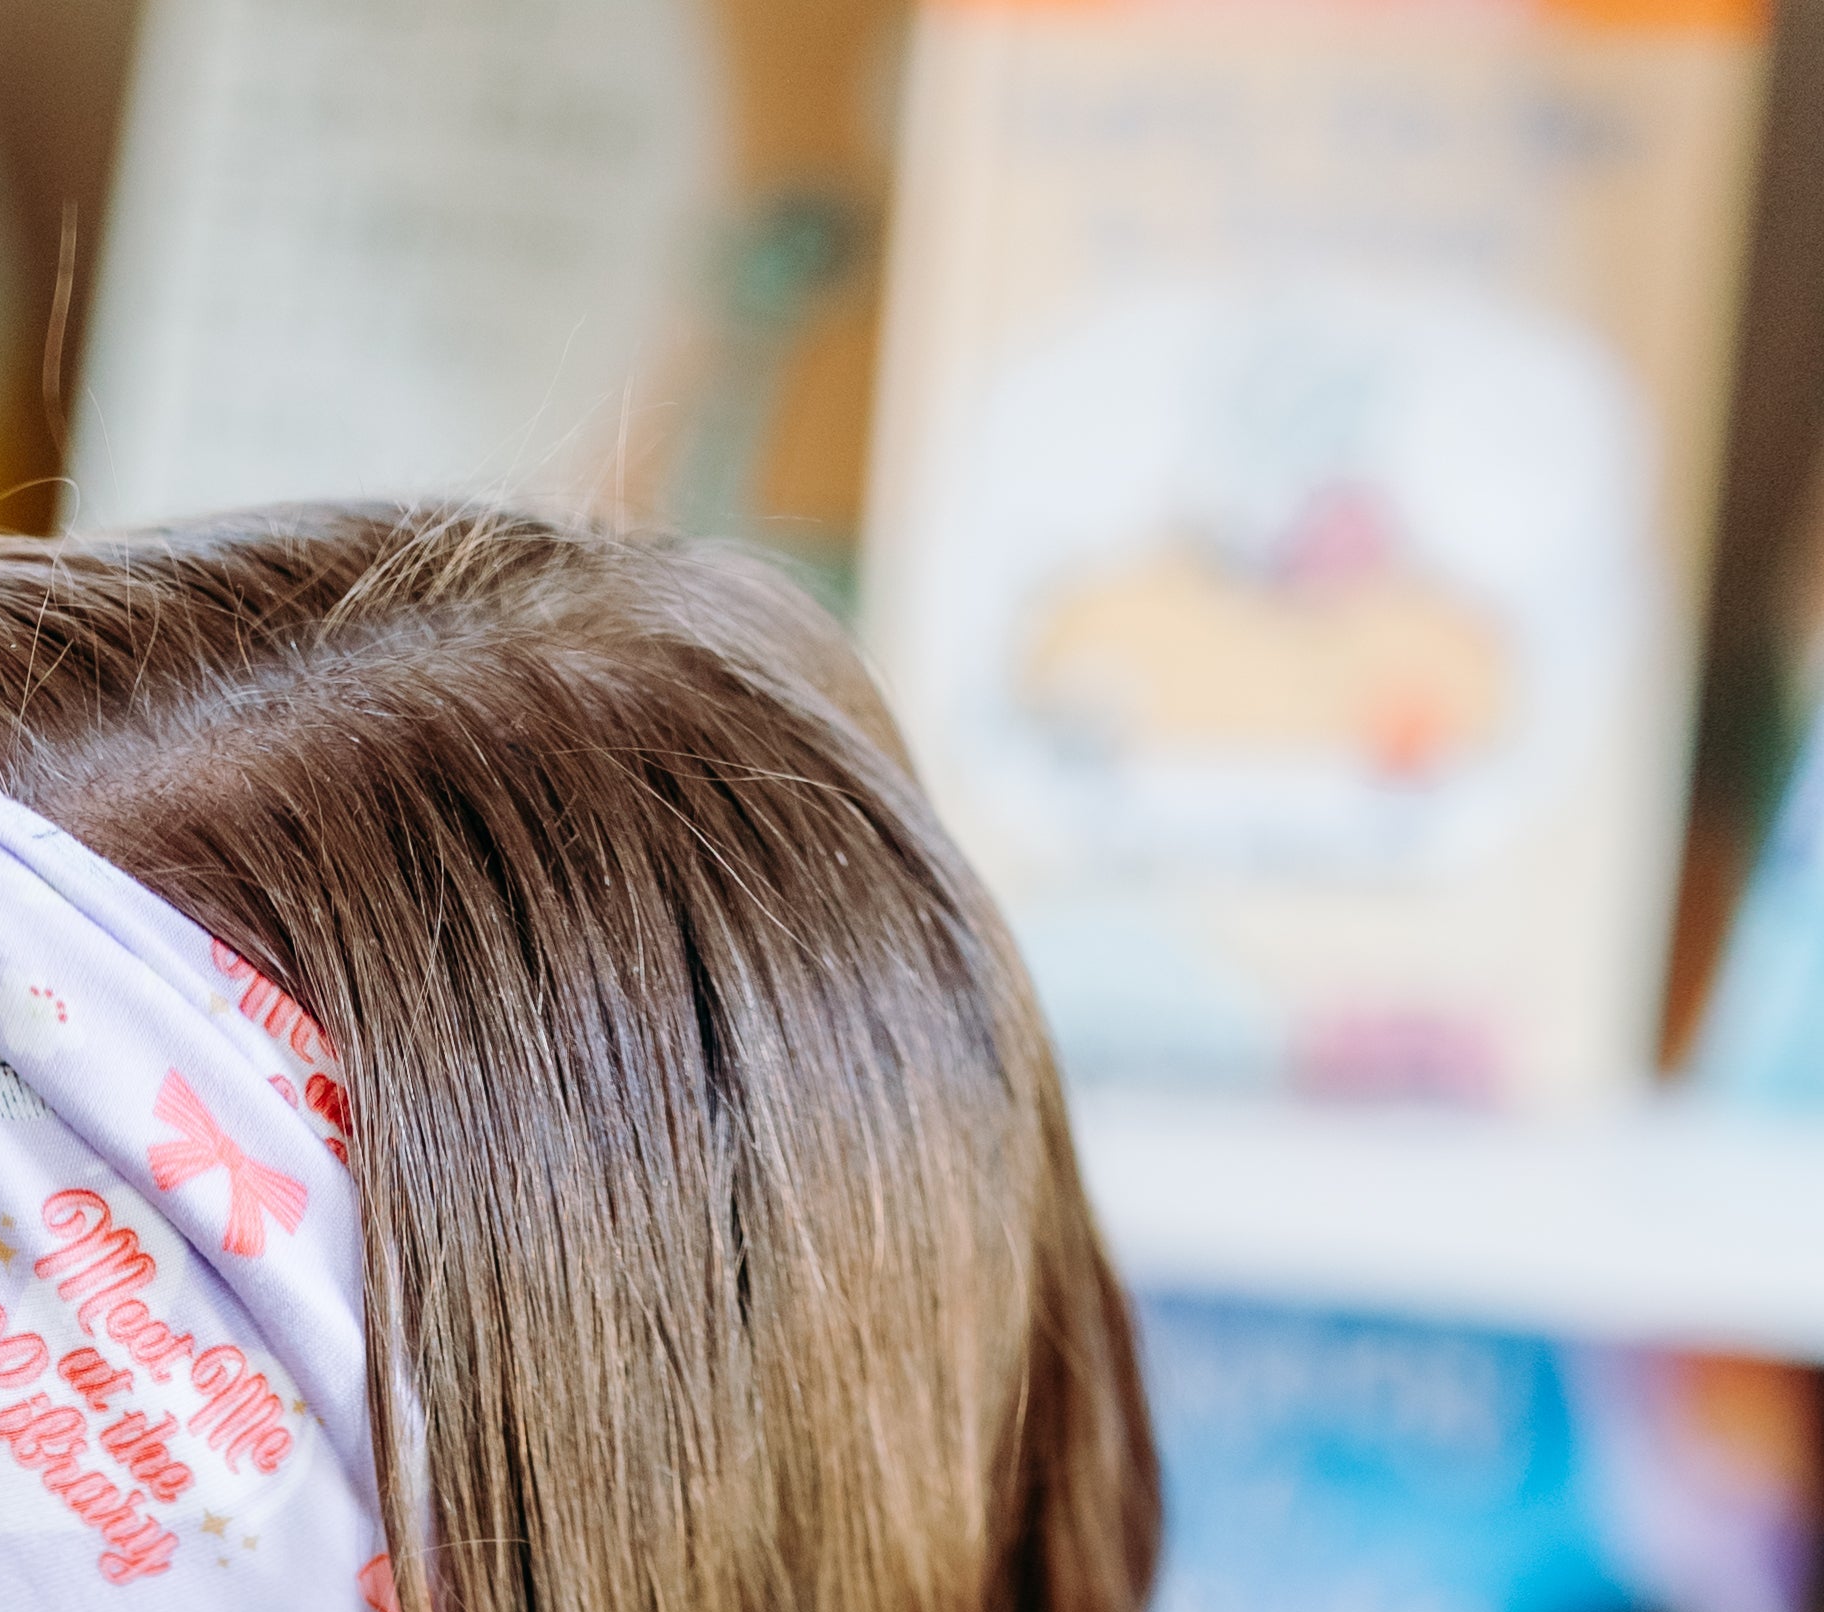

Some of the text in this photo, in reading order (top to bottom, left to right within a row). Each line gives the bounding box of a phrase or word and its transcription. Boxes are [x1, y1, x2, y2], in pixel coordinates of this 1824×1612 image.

[34, 1188, 293, 1475] Meet Me
[58, 1347, 194, 1502] at the
